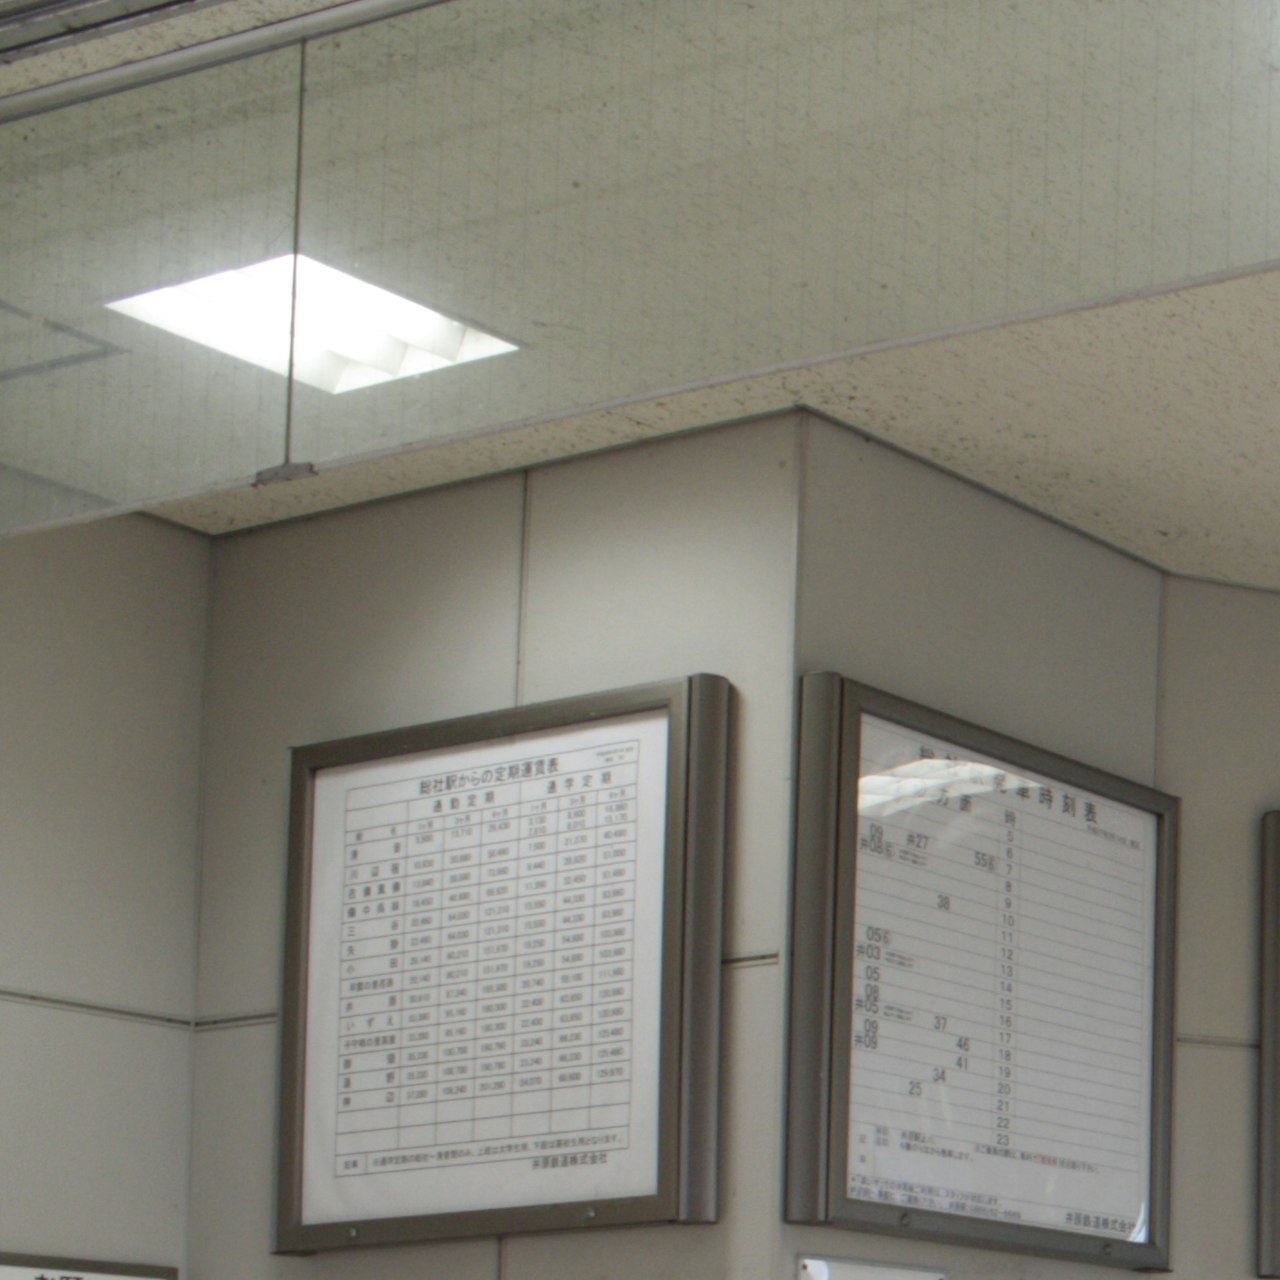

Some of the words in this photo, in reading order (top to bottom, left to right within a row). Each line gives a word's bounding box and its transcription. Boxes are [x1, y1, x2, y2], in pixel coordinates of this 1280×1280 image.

[933, 1015, 948, 1031] 37
[956, 1056, 968, 1070] 41
[932, 1068, 946, 1083] 34
[908, 1080, 923, 1097] 25
